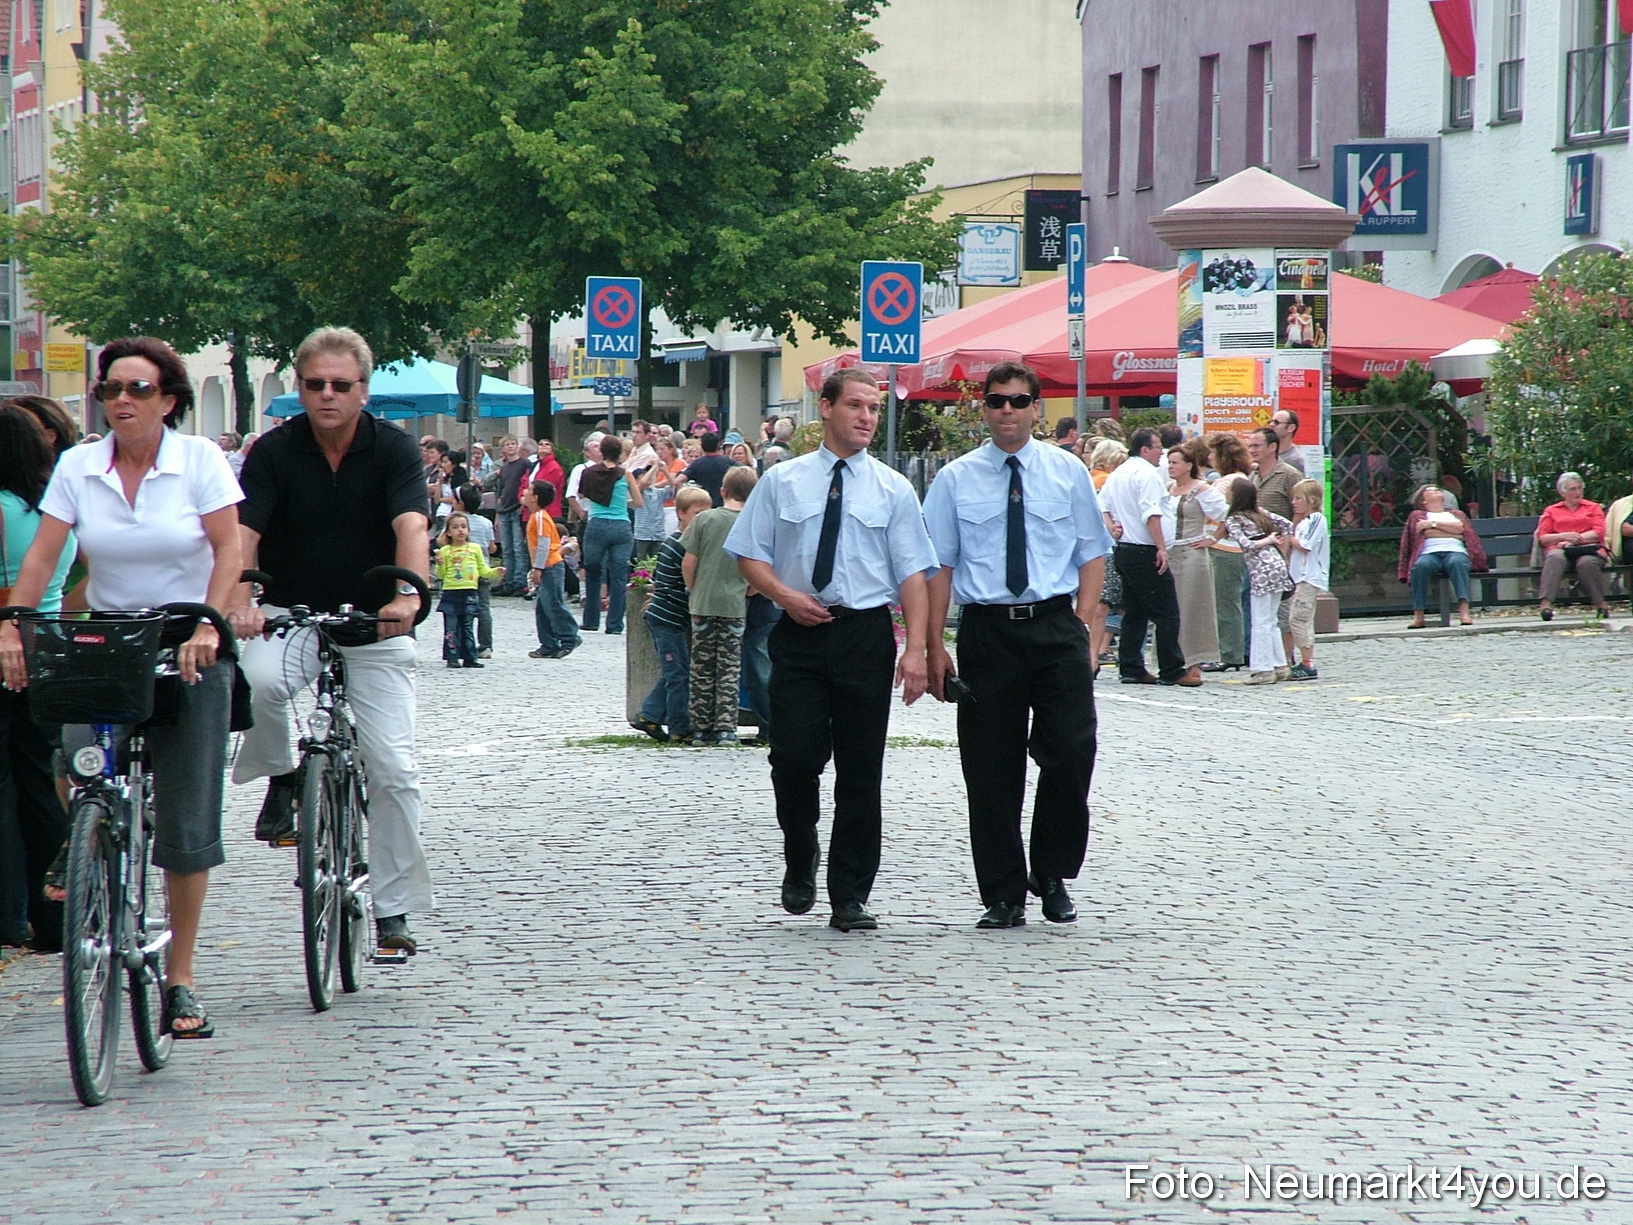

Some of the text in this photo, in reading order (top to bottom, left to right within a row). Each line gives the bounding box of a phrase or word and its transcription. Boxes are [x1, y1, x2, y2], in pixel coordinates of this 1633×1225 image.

[1368, 217, 1416, 225] RUPPERT
[1039, 215, 1061, 262] 浅草
[1070, 234, 1082, 284] P
[591, 334, 634, 352] TAXI
[866, 332, 915, 355] TAXI
[1362, 360, 1398, 371] Hotel
